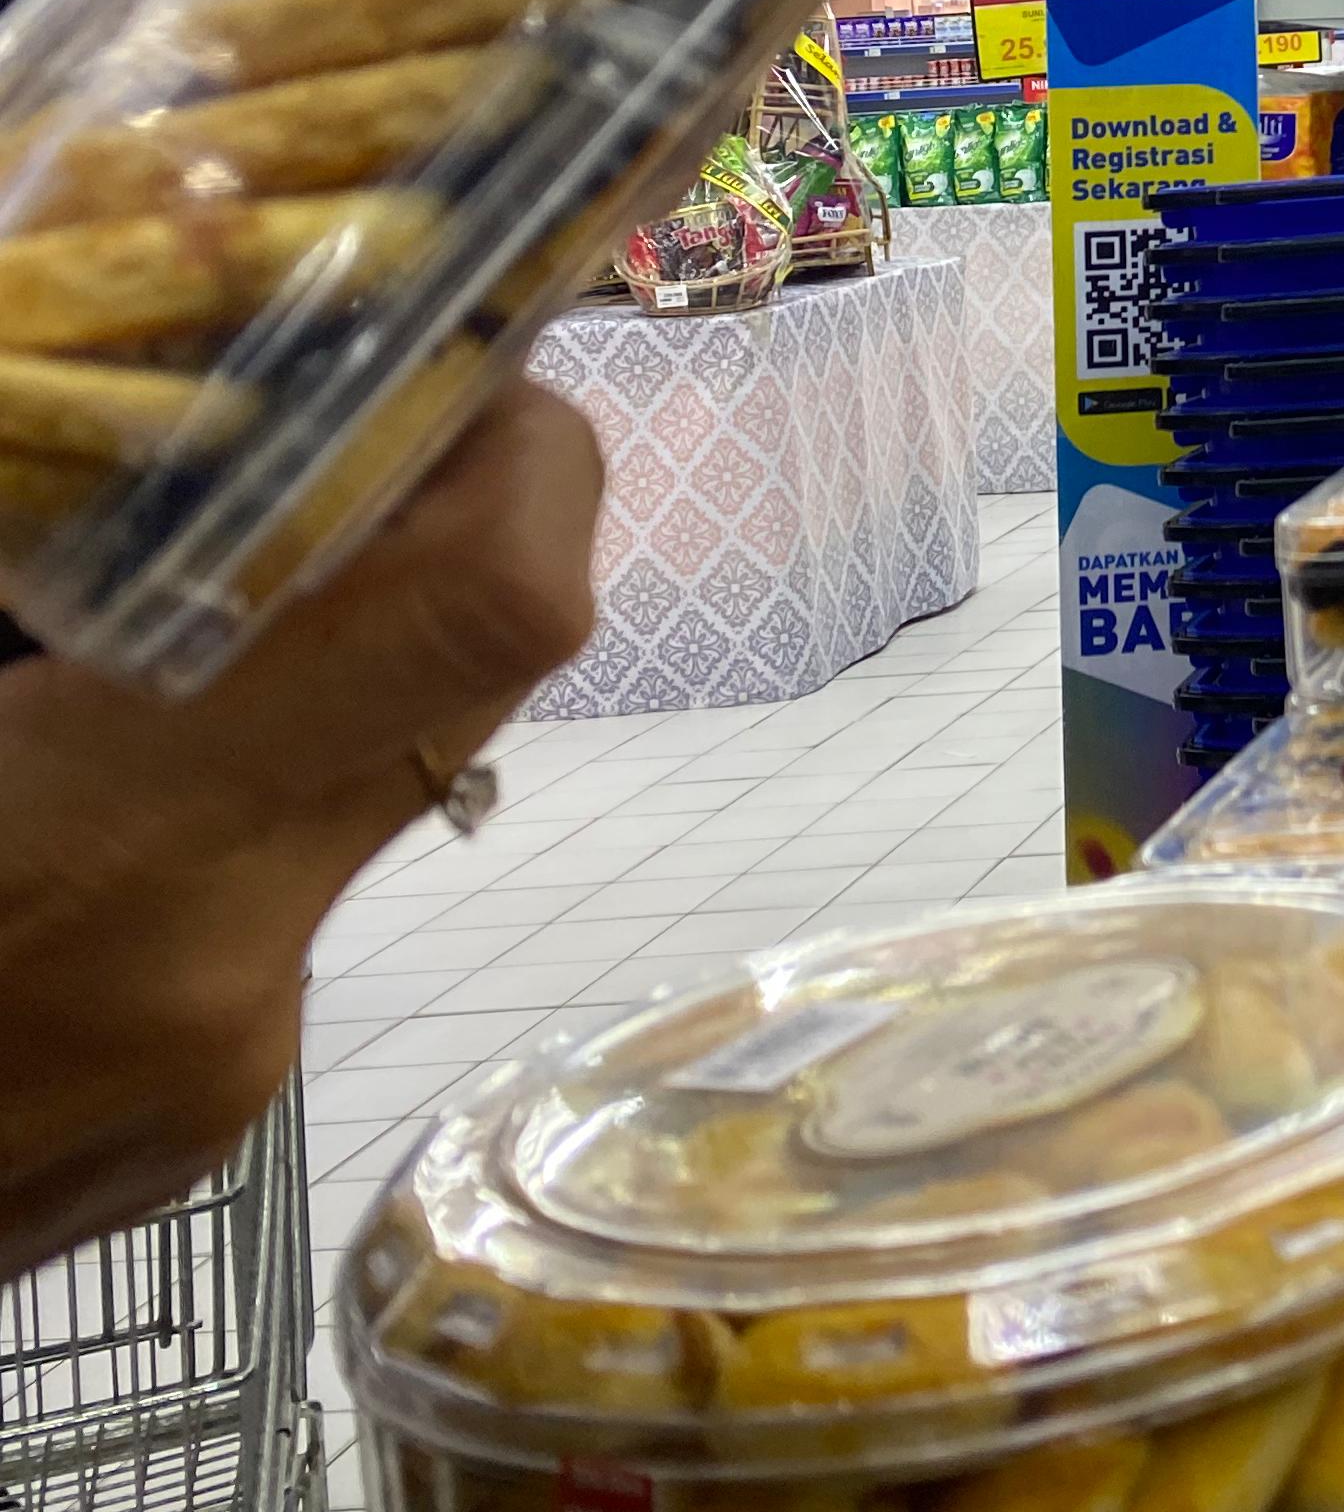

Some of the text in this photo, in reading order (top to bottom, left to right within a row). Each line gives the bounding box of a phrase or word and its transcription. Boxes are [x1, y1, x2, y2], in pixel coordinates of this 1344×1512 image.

[1001, 36, 1045, 62] 25.
[1071, 111, 1238, 139] Download &
[1072, 143, 1214, 174] Registrasi
[1078, 550, 1179, 571] DAPATKAN
[1079, 569, 1169, 606] MEM
